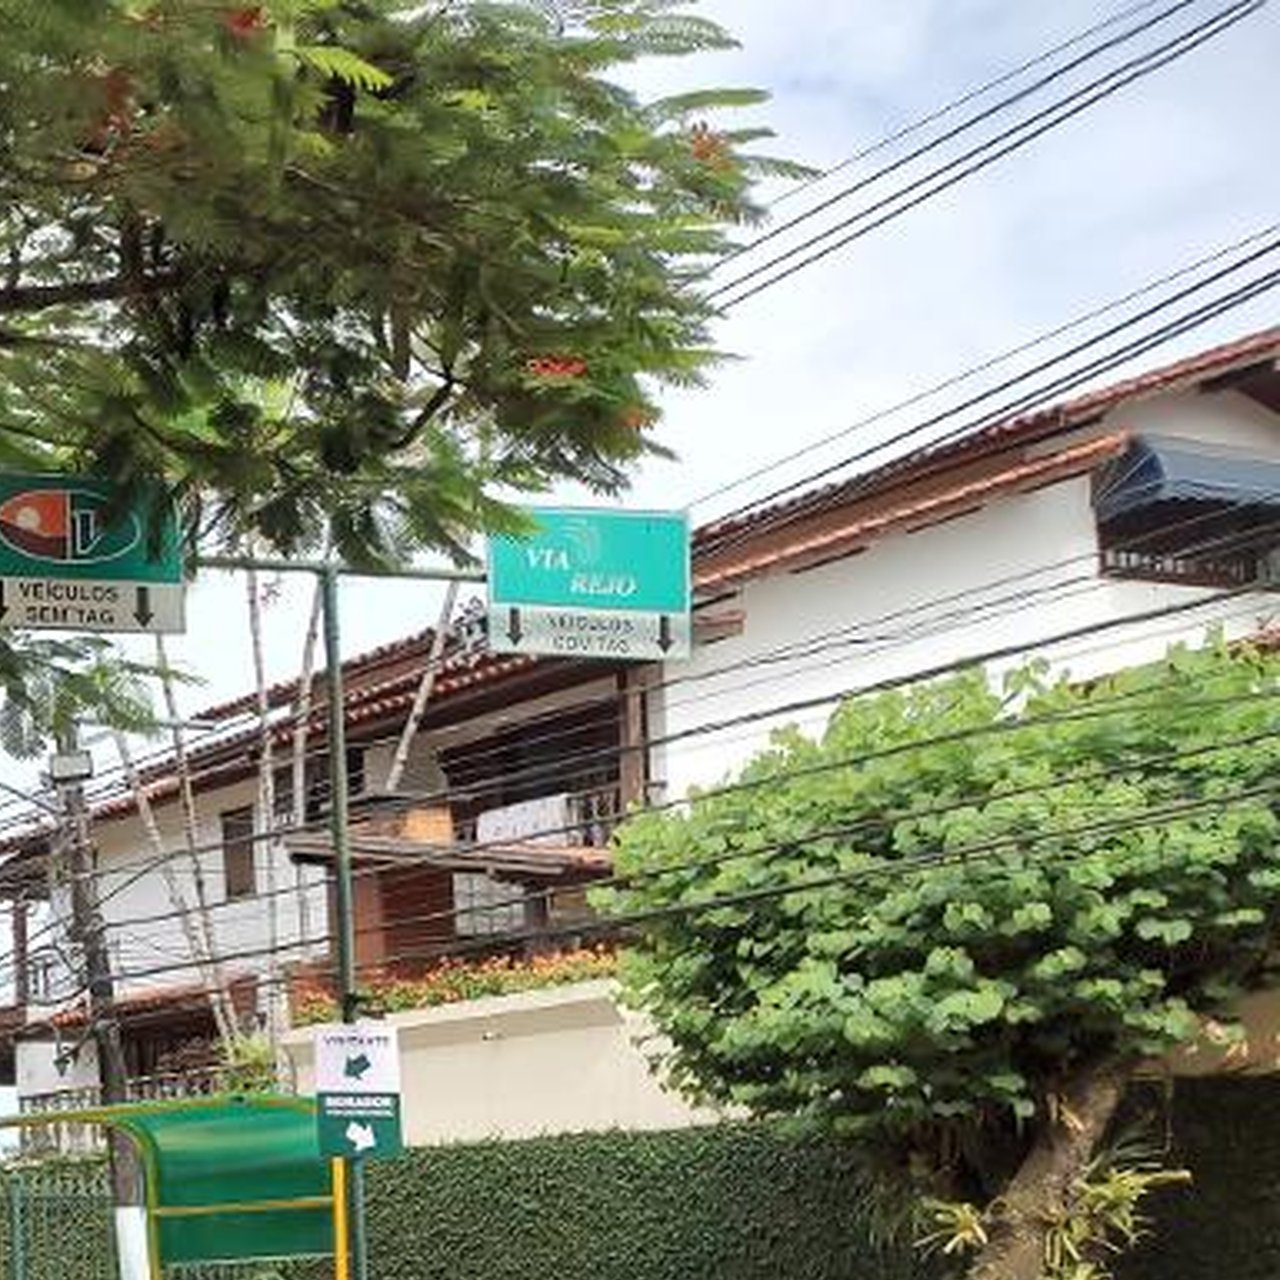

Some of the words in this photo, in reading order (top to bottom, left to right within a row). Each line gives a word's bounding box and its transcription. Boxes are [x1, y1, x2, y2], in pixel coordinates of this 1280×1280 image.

[526, 548, 570, 571] VIA
[18, 580, 120, 602] VEÍCULOS
[77, 608, 116, 626] TAG
